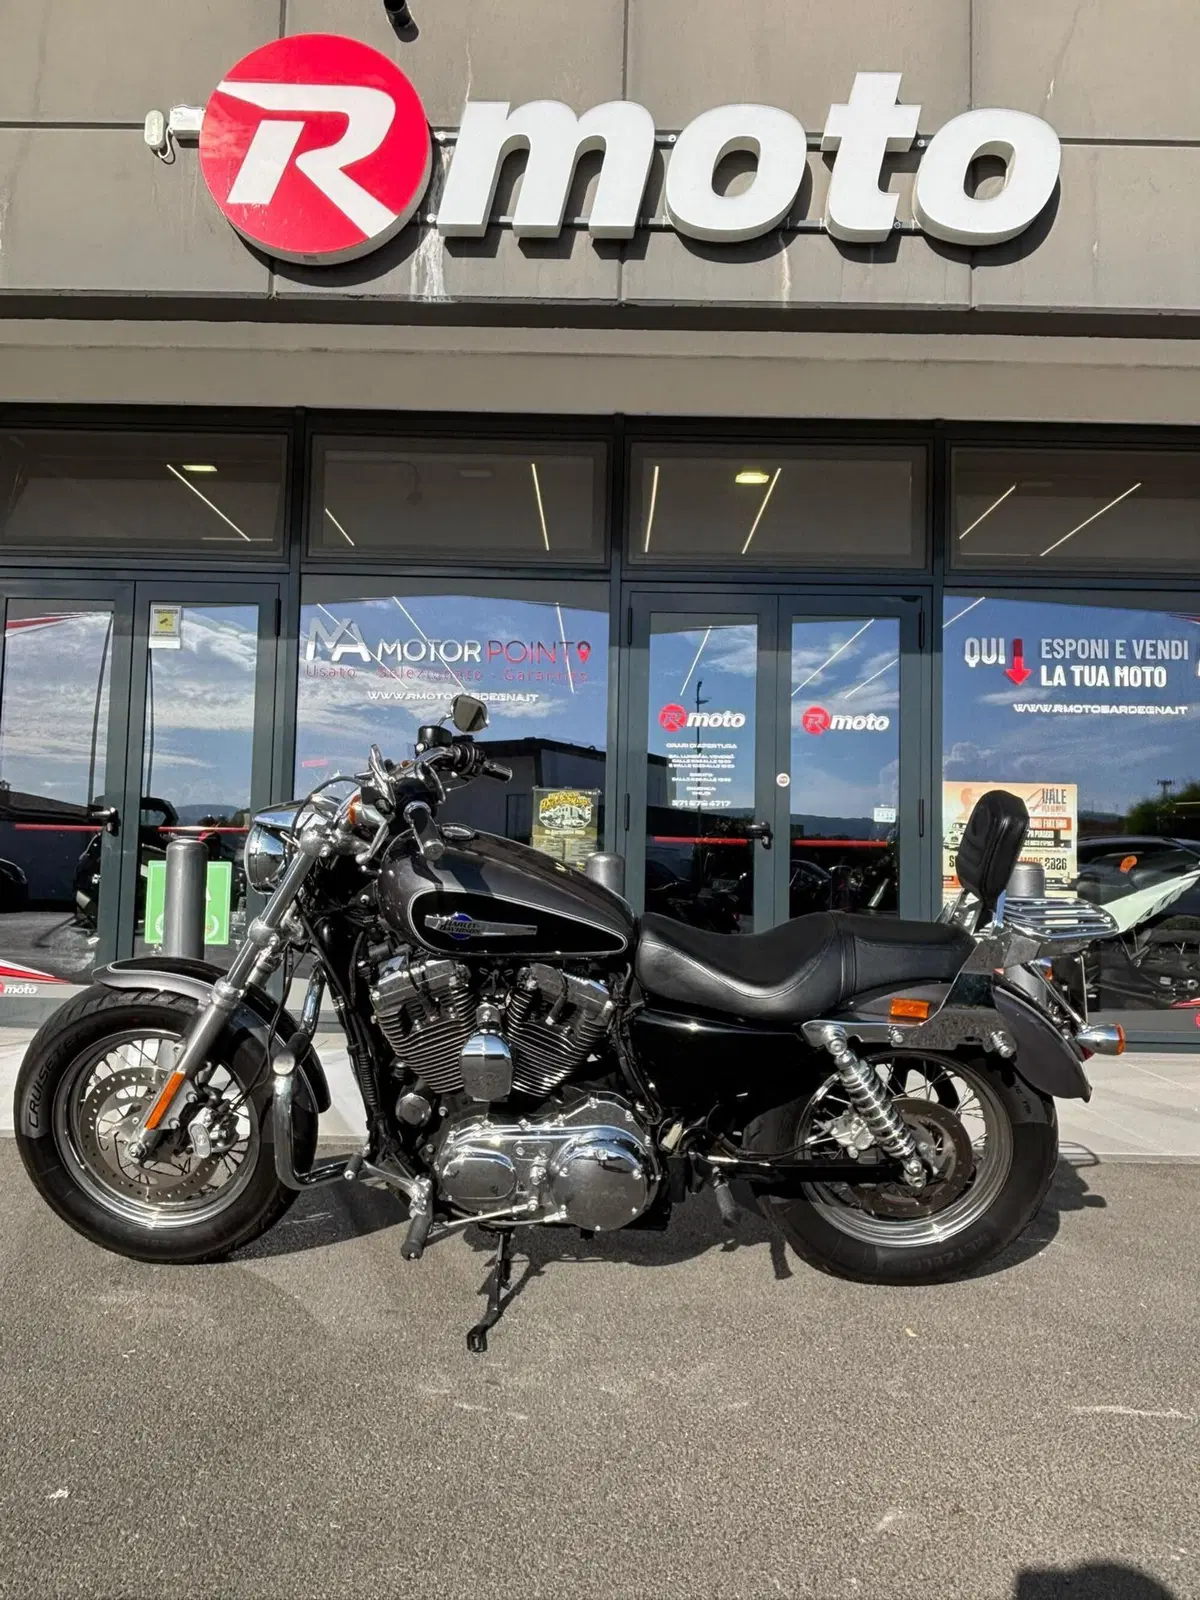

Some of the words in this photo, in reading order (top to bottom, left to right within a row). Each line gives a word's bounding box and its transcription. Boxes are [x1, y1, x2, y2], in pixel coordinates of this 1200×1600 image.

[377, 638, 482, 663] MOTOR
[487, 639, 575, 665] POINT
[963, 637, 1007, 668] QUI
[1040, 638, 1110, 660] ESPONI
[1115, 639, 1127, 660] E
[1132, 639, 1189, 661] VENDI
[1040, 665, 1067, 687] LA
[1070, 665, 1110, 688] TUA
[1114, 665, 1168, 688] MOTO
[1042, 787, 1067, 805] VALE
[3, 983, 38, 995] moto
